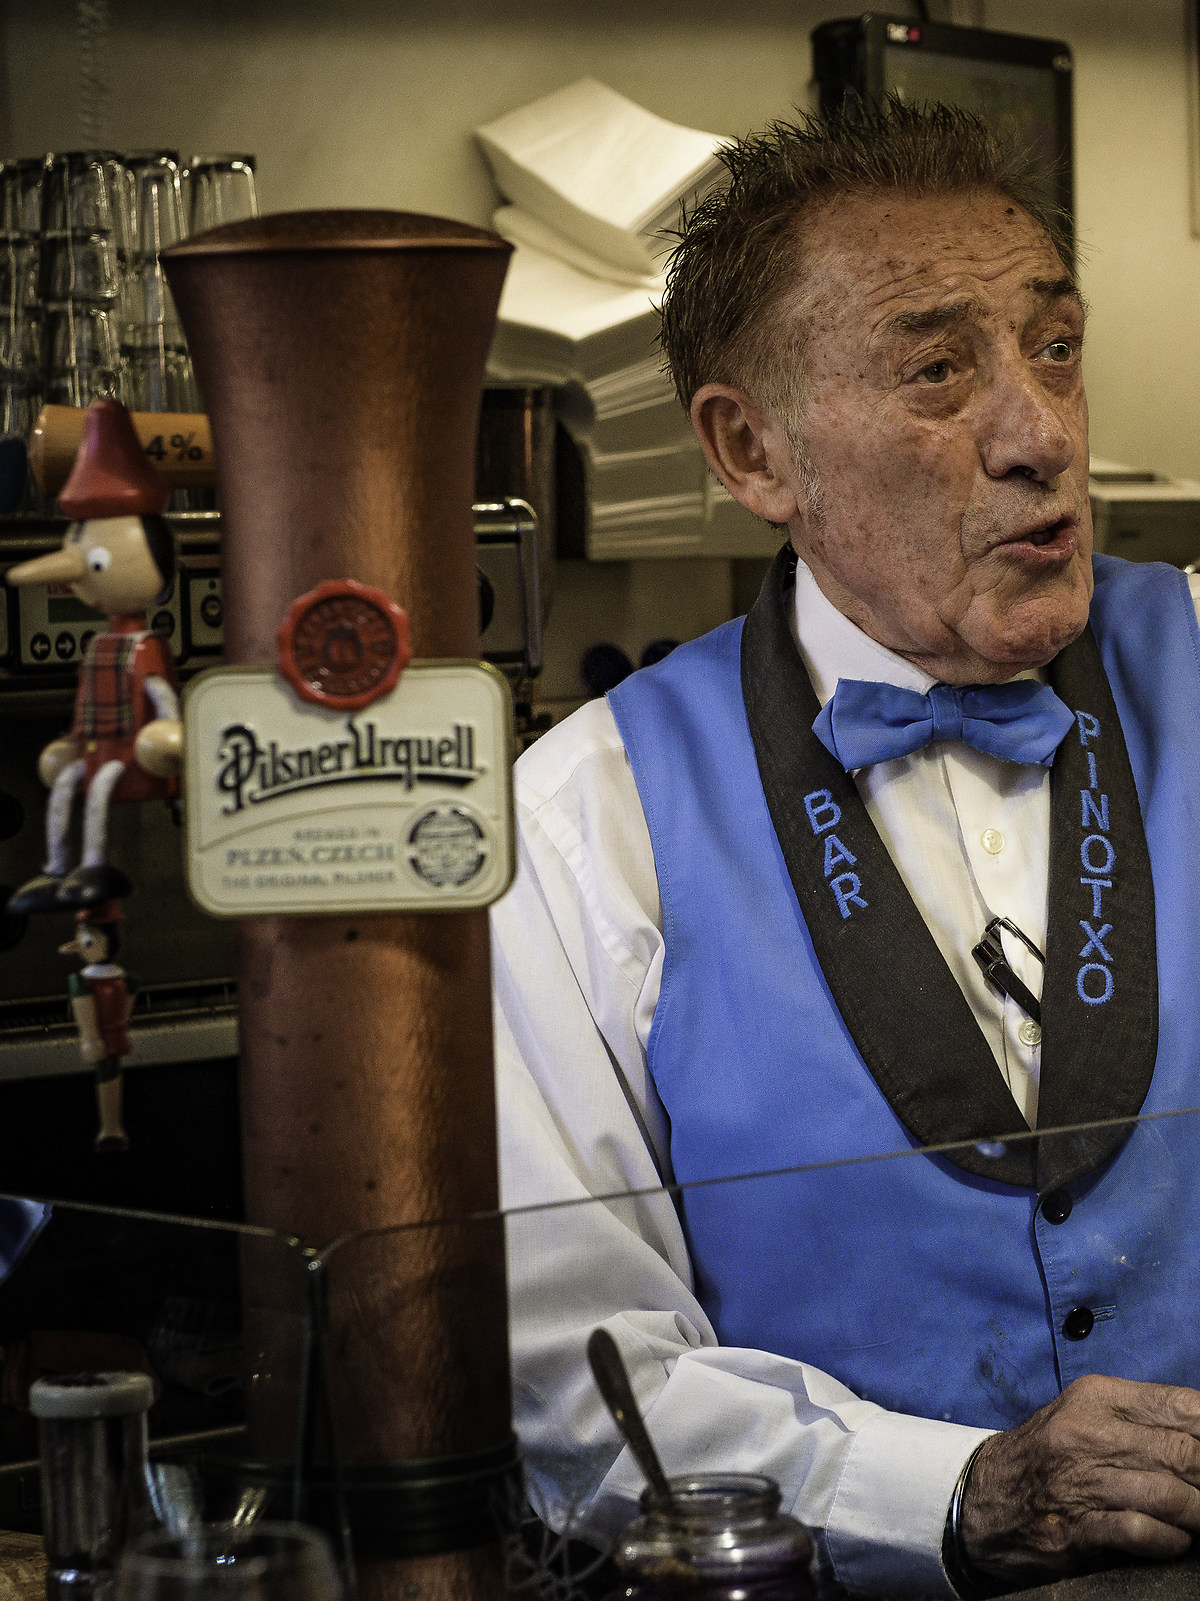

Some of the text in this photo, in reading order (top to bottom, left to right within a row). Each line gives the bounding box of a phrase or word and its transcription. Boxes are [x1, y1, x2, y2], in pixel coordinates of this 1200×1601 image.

[218, 719, 477, 816] Pilsner Urquell
[311, 844, 394, 863] CZECH
[803, 787, 869, 920] BAR
[1075, 709, 1118, 1007] PINOTXO
